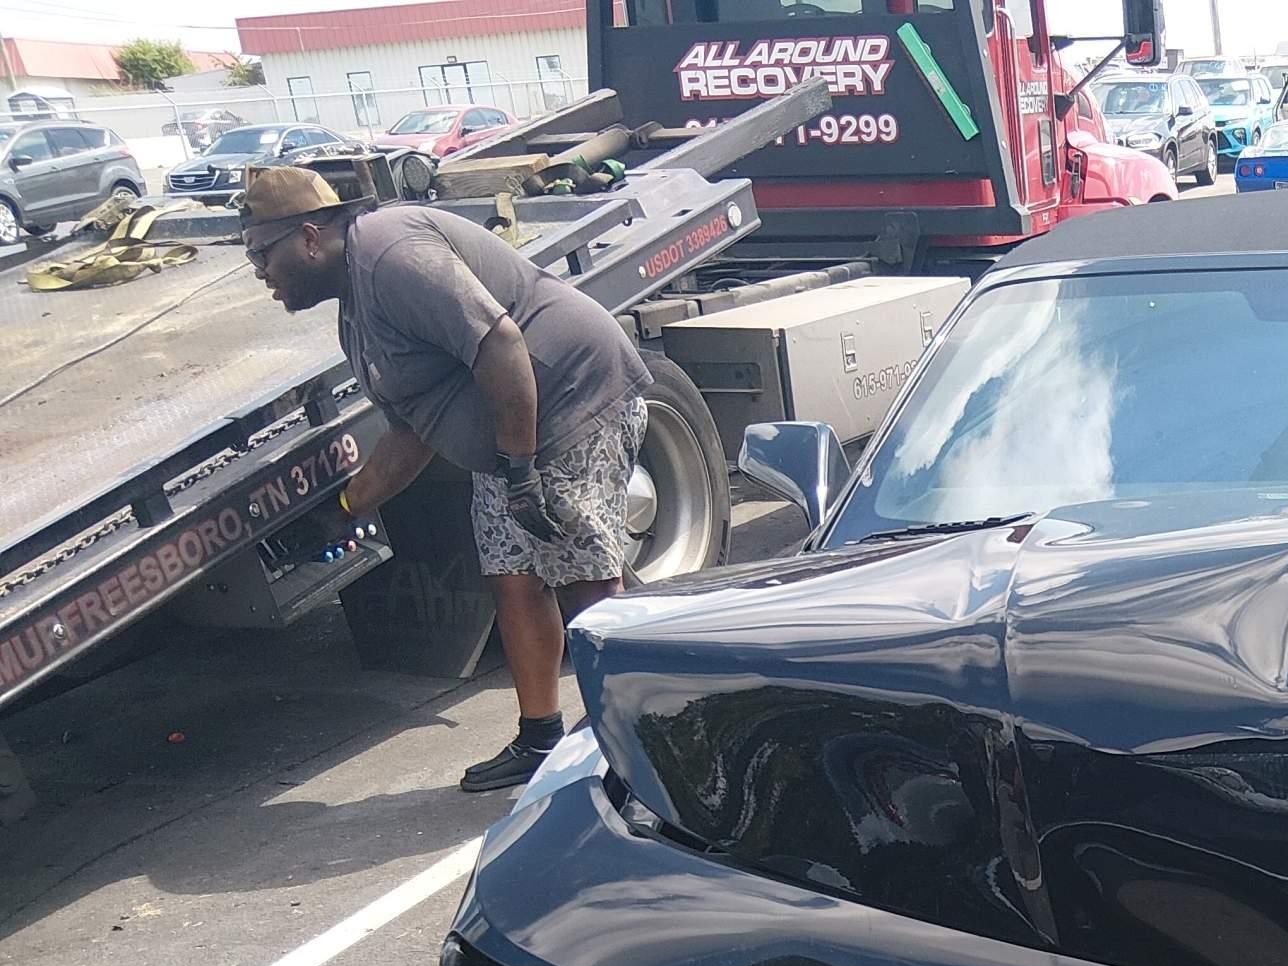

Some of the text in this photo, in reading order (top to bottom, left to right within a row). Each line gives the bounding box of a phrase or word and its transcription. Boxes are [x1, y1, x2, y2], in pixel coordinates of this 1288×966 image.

[679, 38, 888, 68] ALL AROUND
[645, 214, 729, 278] USDOT 3389426
[249, 476, 291, 521] TN
[290, 433, 359, 496] 37129
